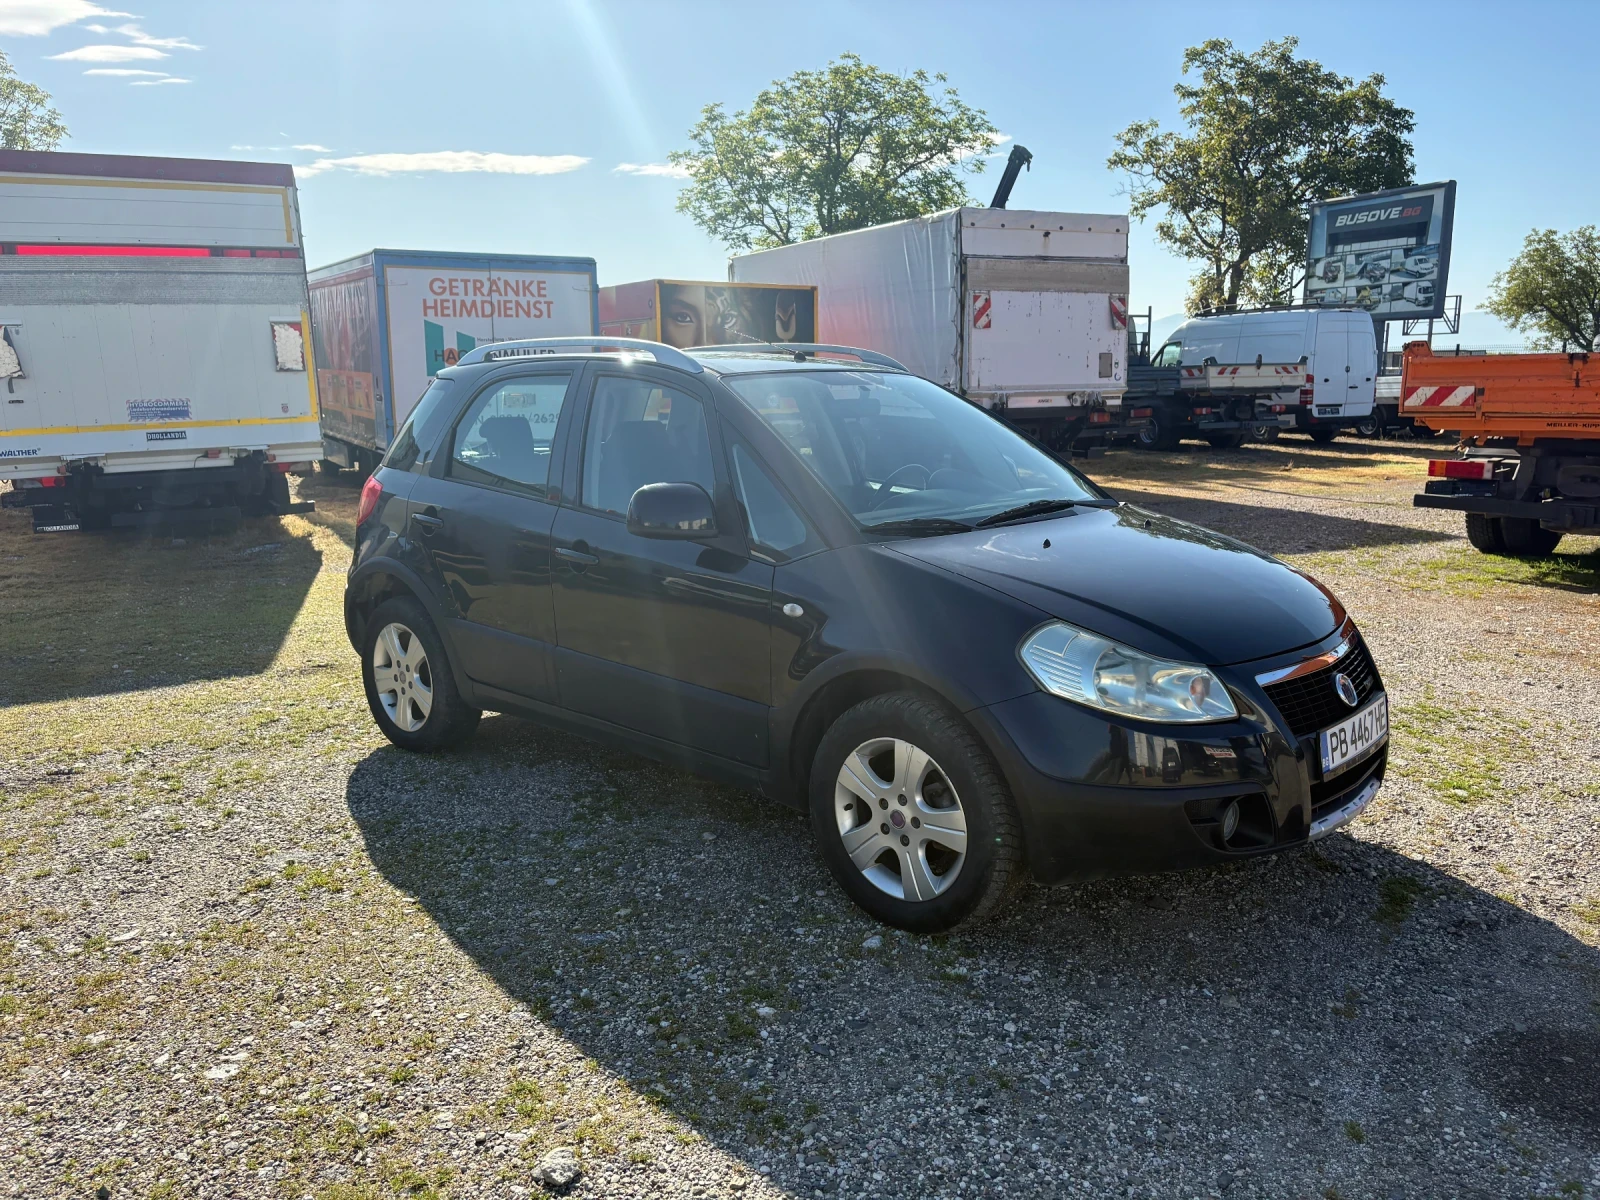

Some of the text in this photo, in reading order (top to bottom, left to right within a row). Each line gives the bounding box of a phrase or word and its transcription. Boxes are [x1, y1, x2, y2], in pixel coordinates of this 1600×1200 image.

[1335, 206, 1422, 227] BUSOVE.BG
[428, 276, 548, 298] GETRÄNKE
[422, 298, 554, 319] HEIMDIENST
[147, 432, 186, 440] DHOLLANDIA
[1329, 701, 1386, 764] PB 4467 HE
